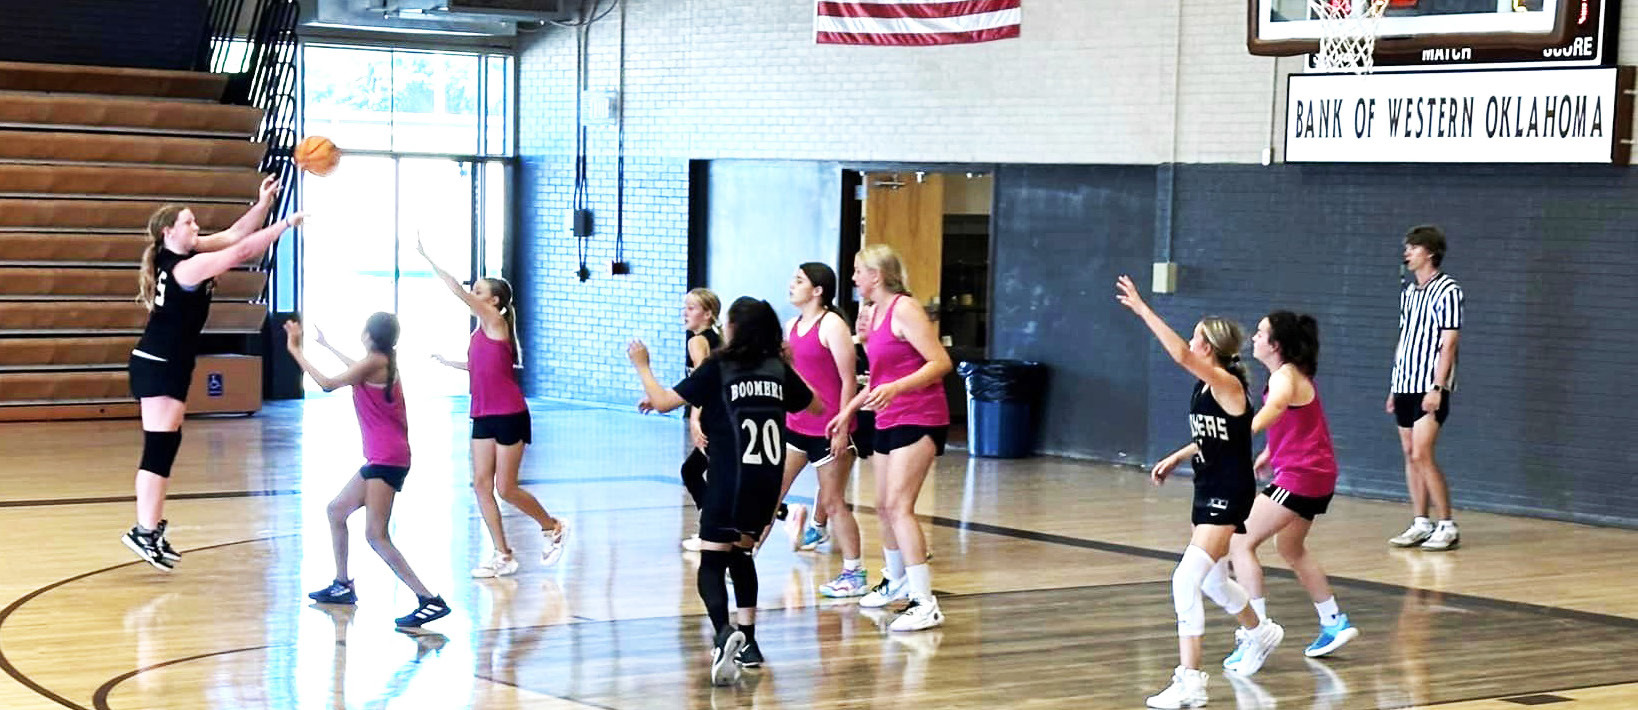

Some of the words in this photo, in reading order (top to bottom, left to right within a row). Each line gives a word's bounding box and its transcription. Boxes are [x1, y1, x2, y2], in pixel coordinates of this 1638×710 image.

[1421, 48, 1471, 61] MATCH
[1295, 98, 1344, 139] BANK
[1354, 97, 1376, 139] OF
[1388, 96, 1475, 138] WESTERN
[1485, 95, 1603, 139] OKLAHOMA
[741, 418, 782, 466] 20
